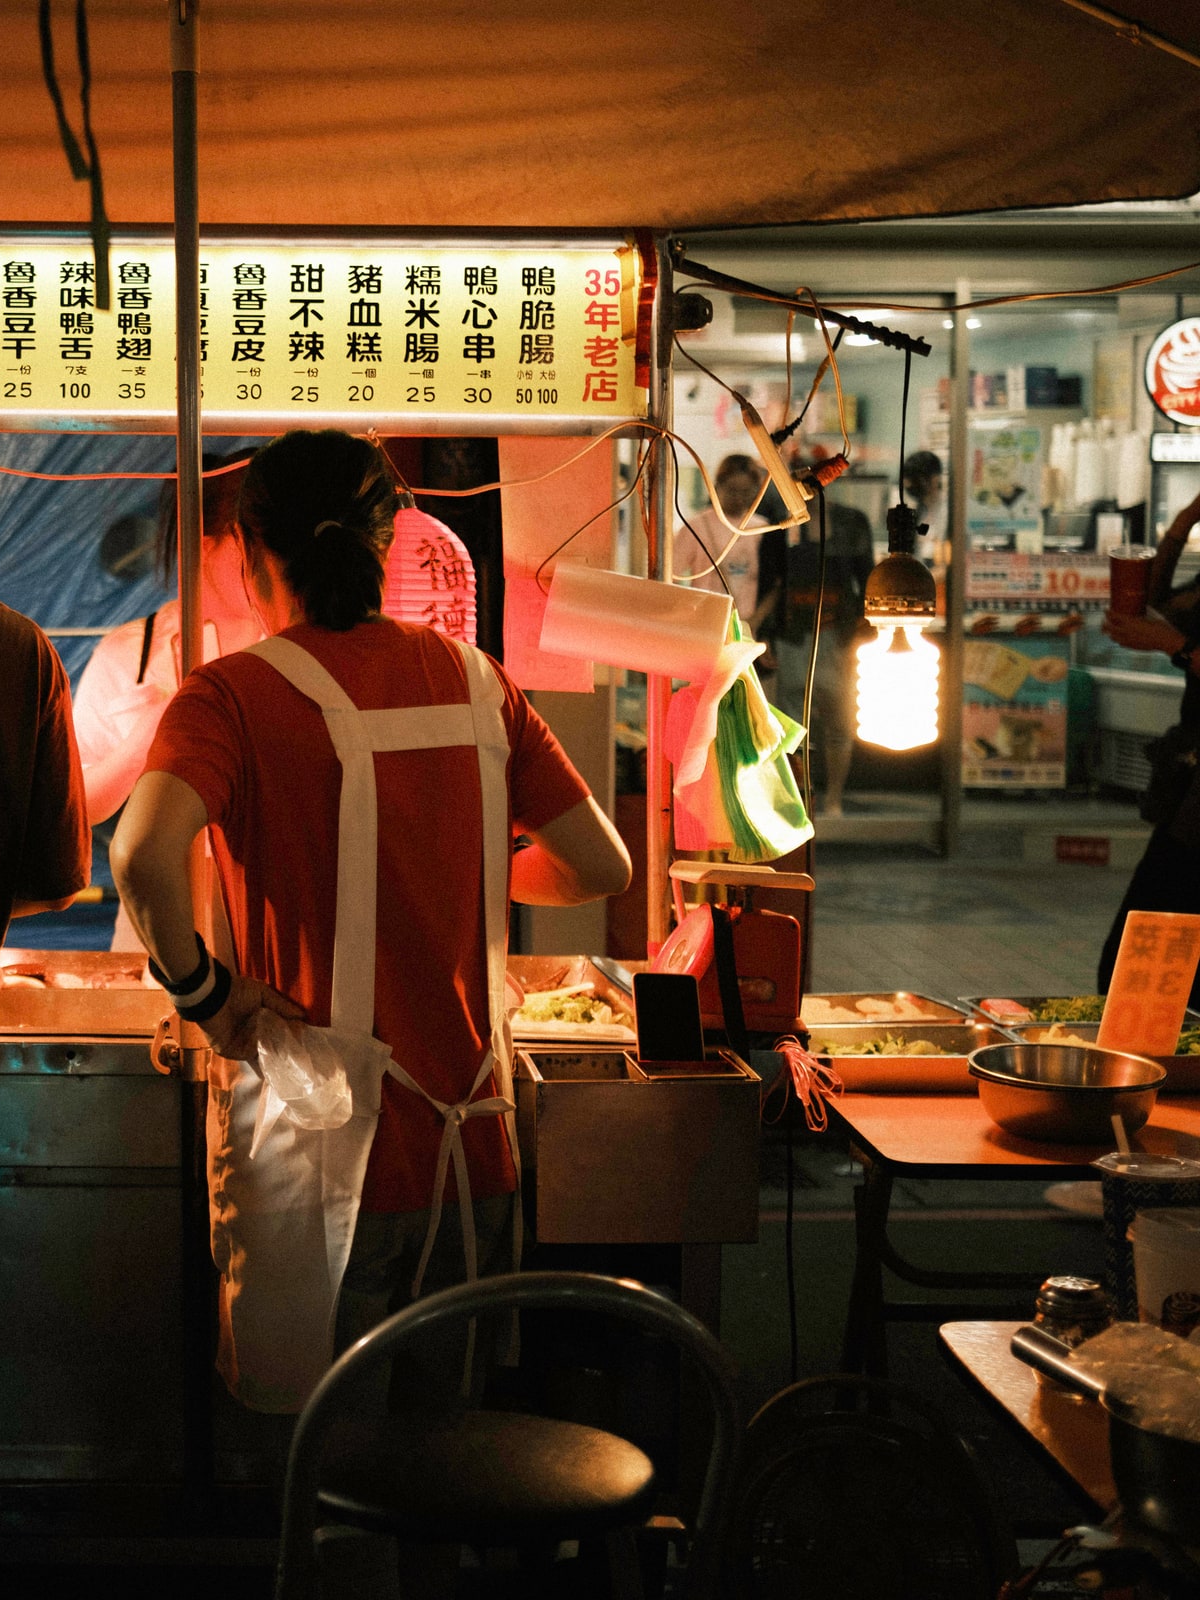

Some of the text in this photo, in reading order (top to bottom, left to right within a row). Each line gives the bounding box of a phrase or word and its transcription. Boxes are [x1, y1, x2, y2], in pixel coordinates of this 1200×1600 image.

[1, 261, 37, 359] 魯香豆干
[59, 261, 95, 360] 辣味鴨舌
[116, 262, 152, 361] 魯香鴨翅
[231, 263, 267, 362] 魯香豆皮
[288, 264, 325, 363] 甜不辣
[346, 264, 383, 363] 豬血糕
[403, 265, 441, 364] 糯米腸
[461, 265, 498, 364] 鴨心串
[518, 266, 556, 365] 鴨脆腸
[582, 268, 620, 402] 35年老店
[6, 365, 32, 376] 一份
[236, 367, 261, 378] 一份
[294, 367, 319, 378] 一份
[467, 369, 492, 380] 一串
[4, 382, 32, 398] 25
[59, 383, 91, 399] 100
[118, 383, 146, 399] 35
[236, 384, 263, 400] 30
[291, 386, 319, 402] 25
[348, 385, 375, 401] 20
[406, 386, 435, 402] 25
[464, 388, 492, 403] 30
[516, 388, 558, 404] 50 100
